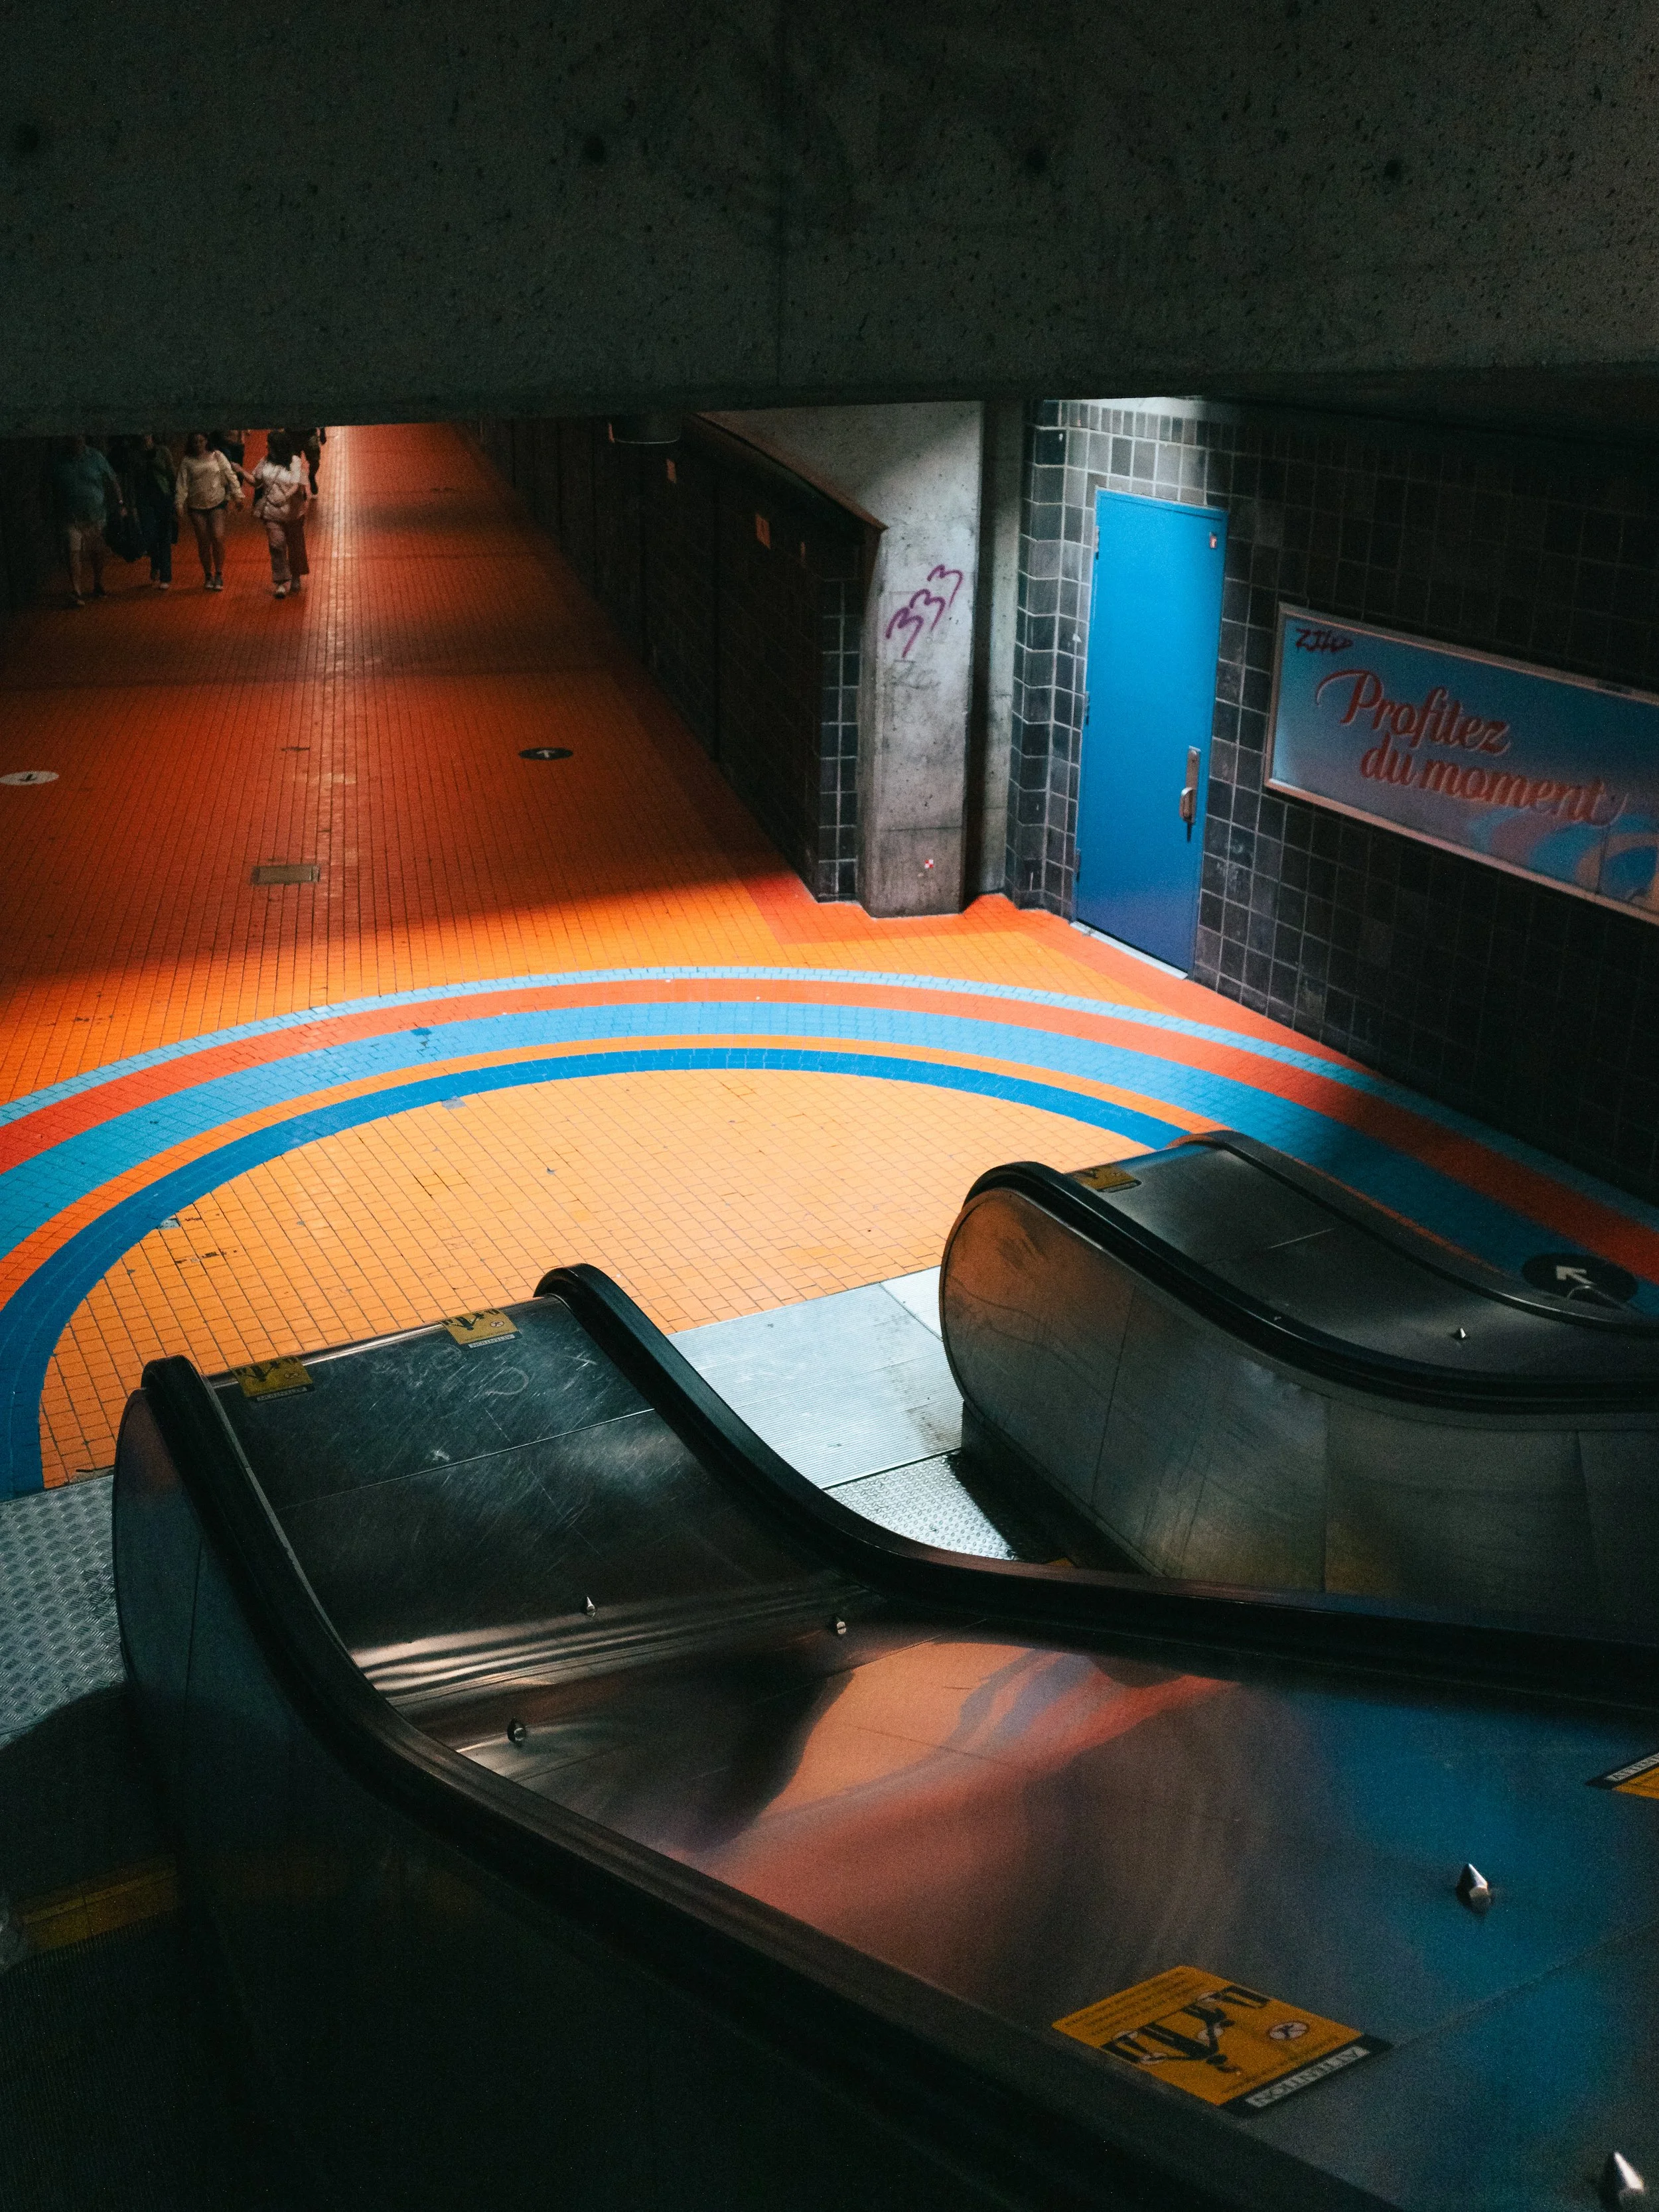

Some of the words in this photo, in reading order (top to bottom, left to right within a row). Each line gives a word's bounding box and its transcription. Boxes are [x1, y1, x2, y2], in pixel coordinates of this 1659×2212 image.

[1316, 669, 1511, 756] Profitez
[1360, 733, 1416, 786] du
[1419, 758, 1626, 827] moment
